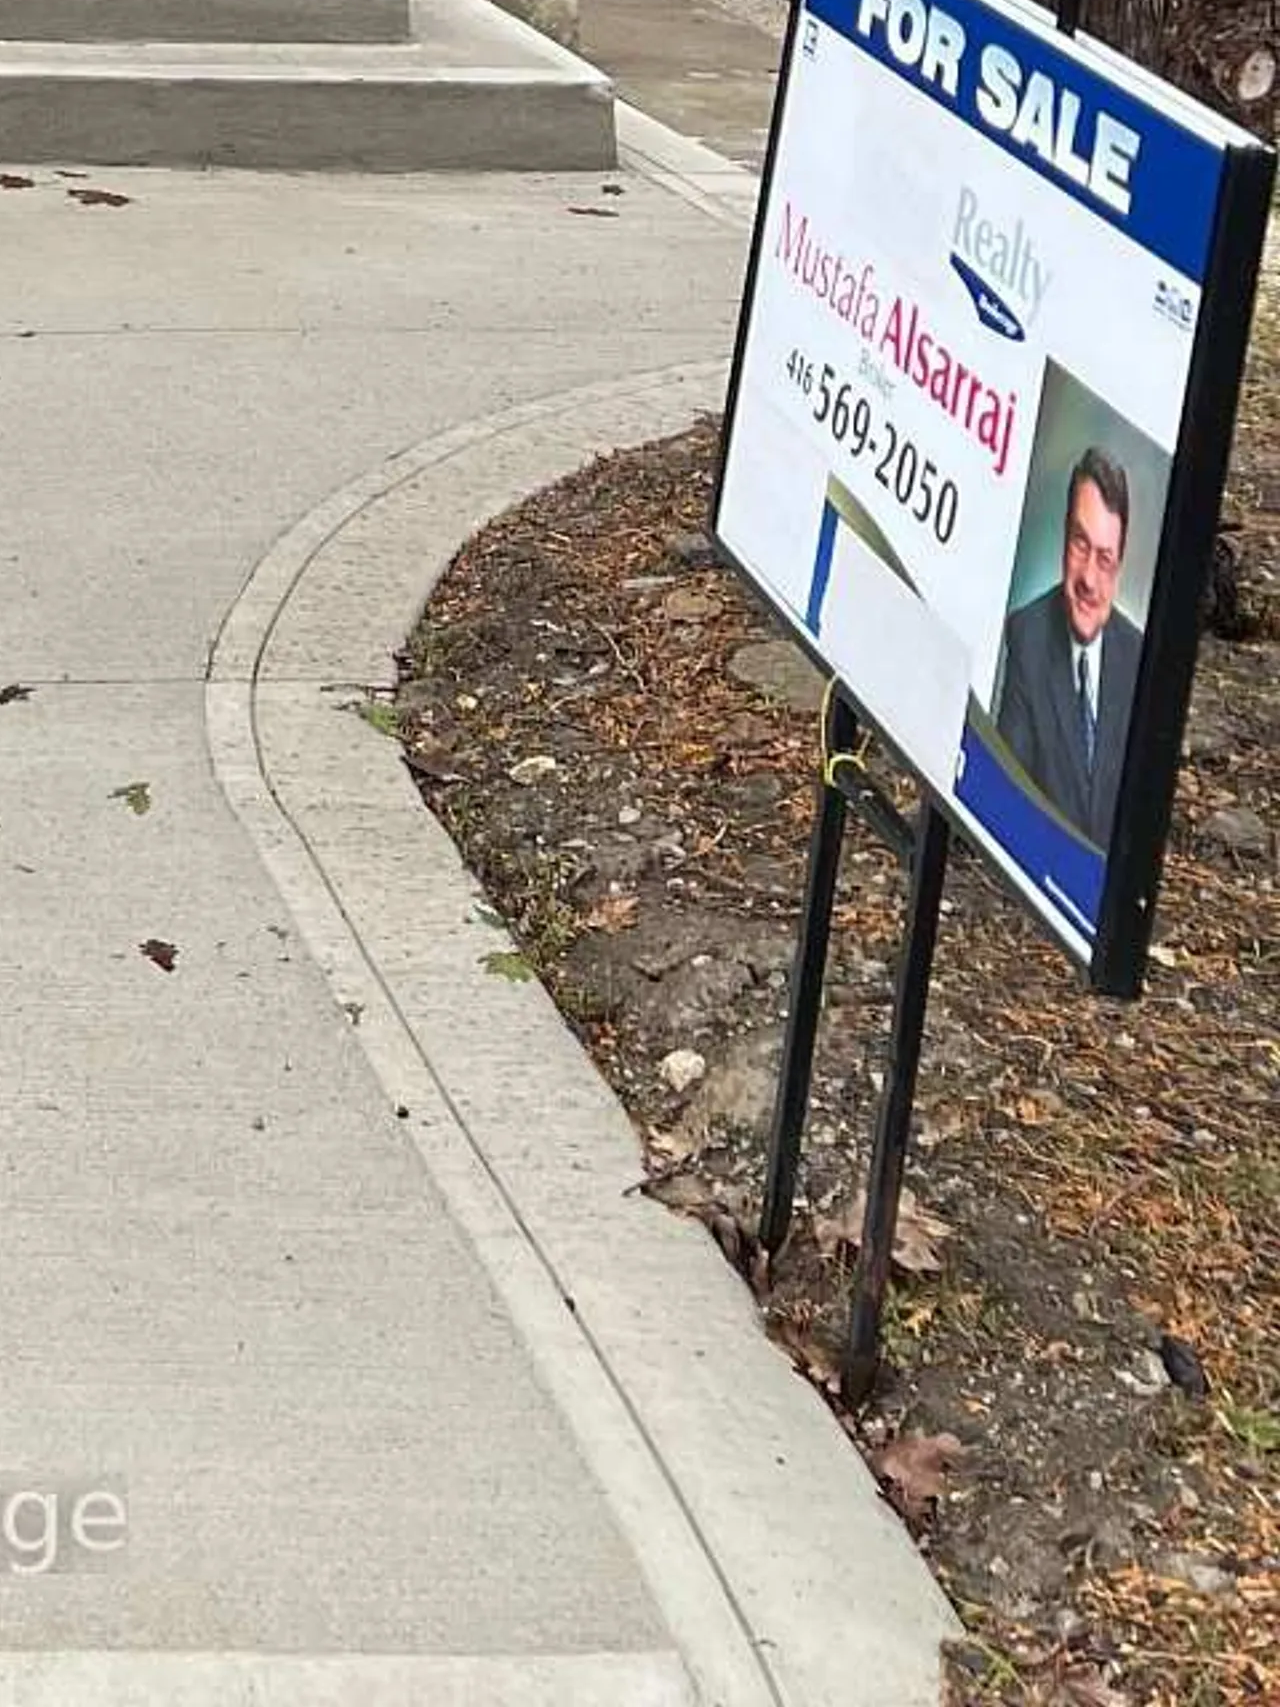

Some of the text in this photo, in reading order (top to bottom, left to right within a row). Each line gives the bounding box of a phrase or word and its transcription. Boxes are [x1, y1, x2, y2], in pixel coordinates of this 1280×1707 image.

[976, 43, 1141, 215] SALE
[775, 201, 1018, 476] Mustafa Alsarraj
[952, 186, 1053, 327] Realty
[786, 348, 960, 544] 416 569-2050
